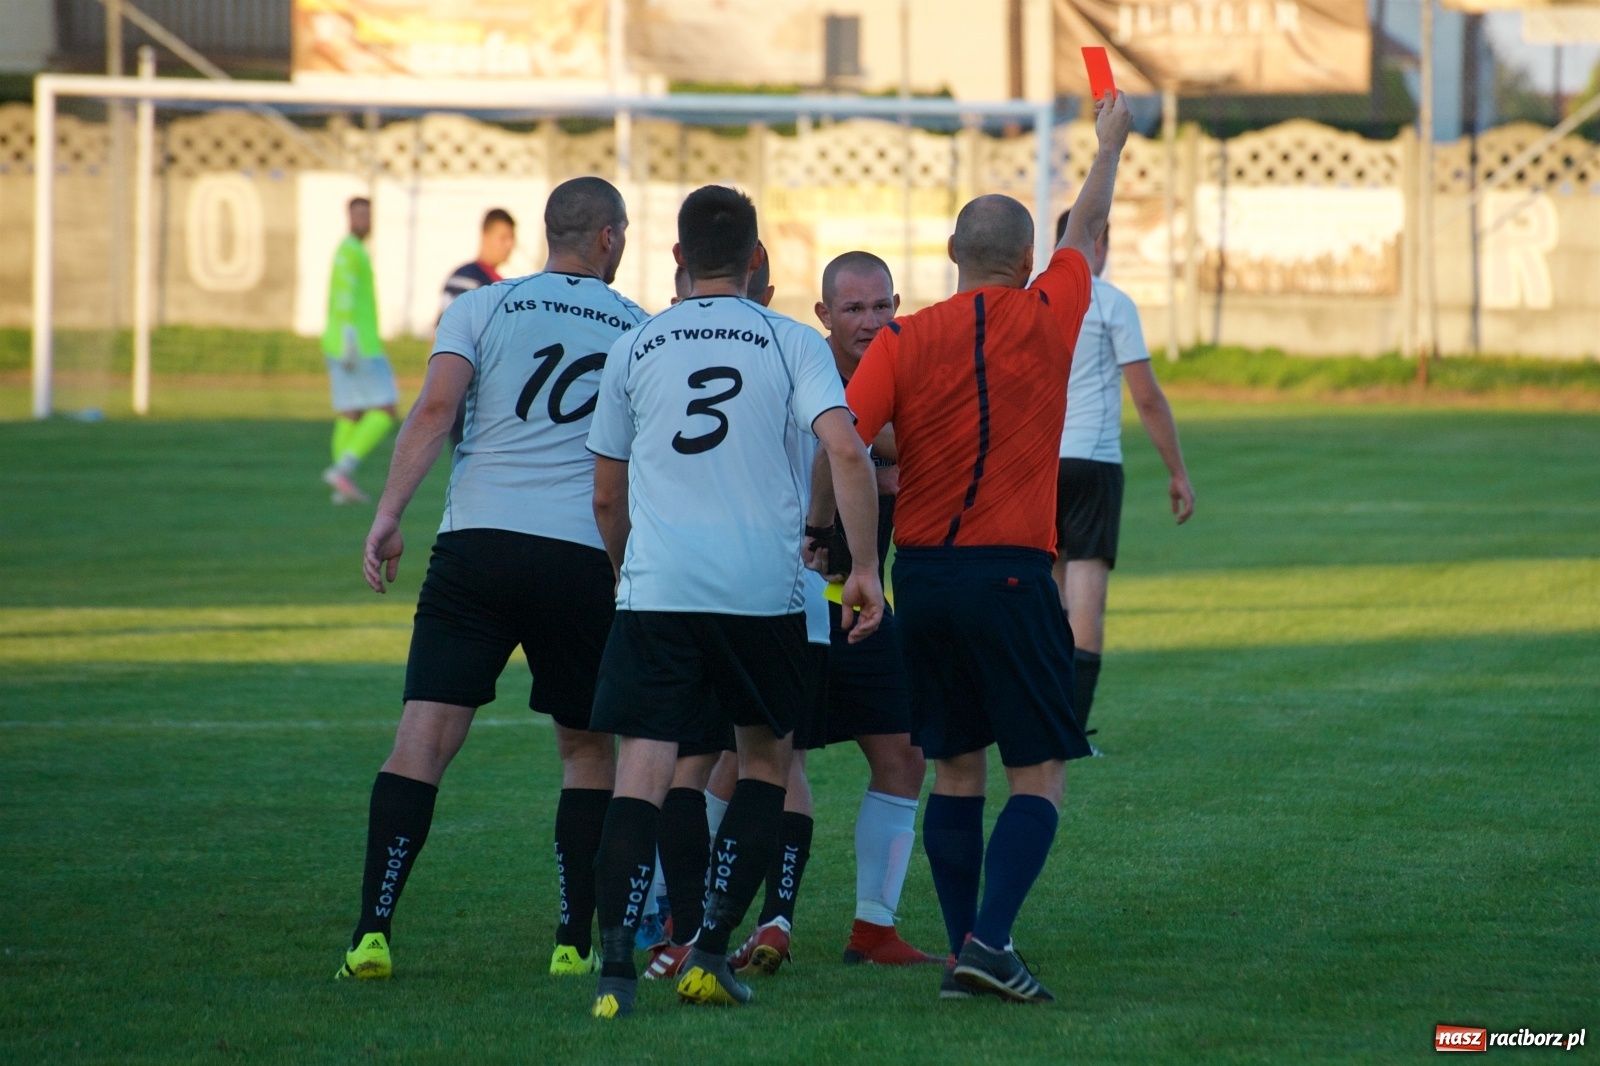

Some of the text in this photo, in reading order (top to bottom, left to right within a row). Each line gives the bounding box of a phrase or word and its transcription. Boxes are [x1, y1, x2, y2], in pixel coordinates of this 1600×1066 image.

[1482, 191, 1559, 308] R
[504, 299, 635, 332] LKS TWORKÓW
[634, 328, 770, 361] LKS TWORKÓW
[515, 343, 608, 424] 10
[671, 366, 743, 454] 3
[375, 836, 410, 918] TWORKÓW
[623, 864, 651, 928] TWORK
